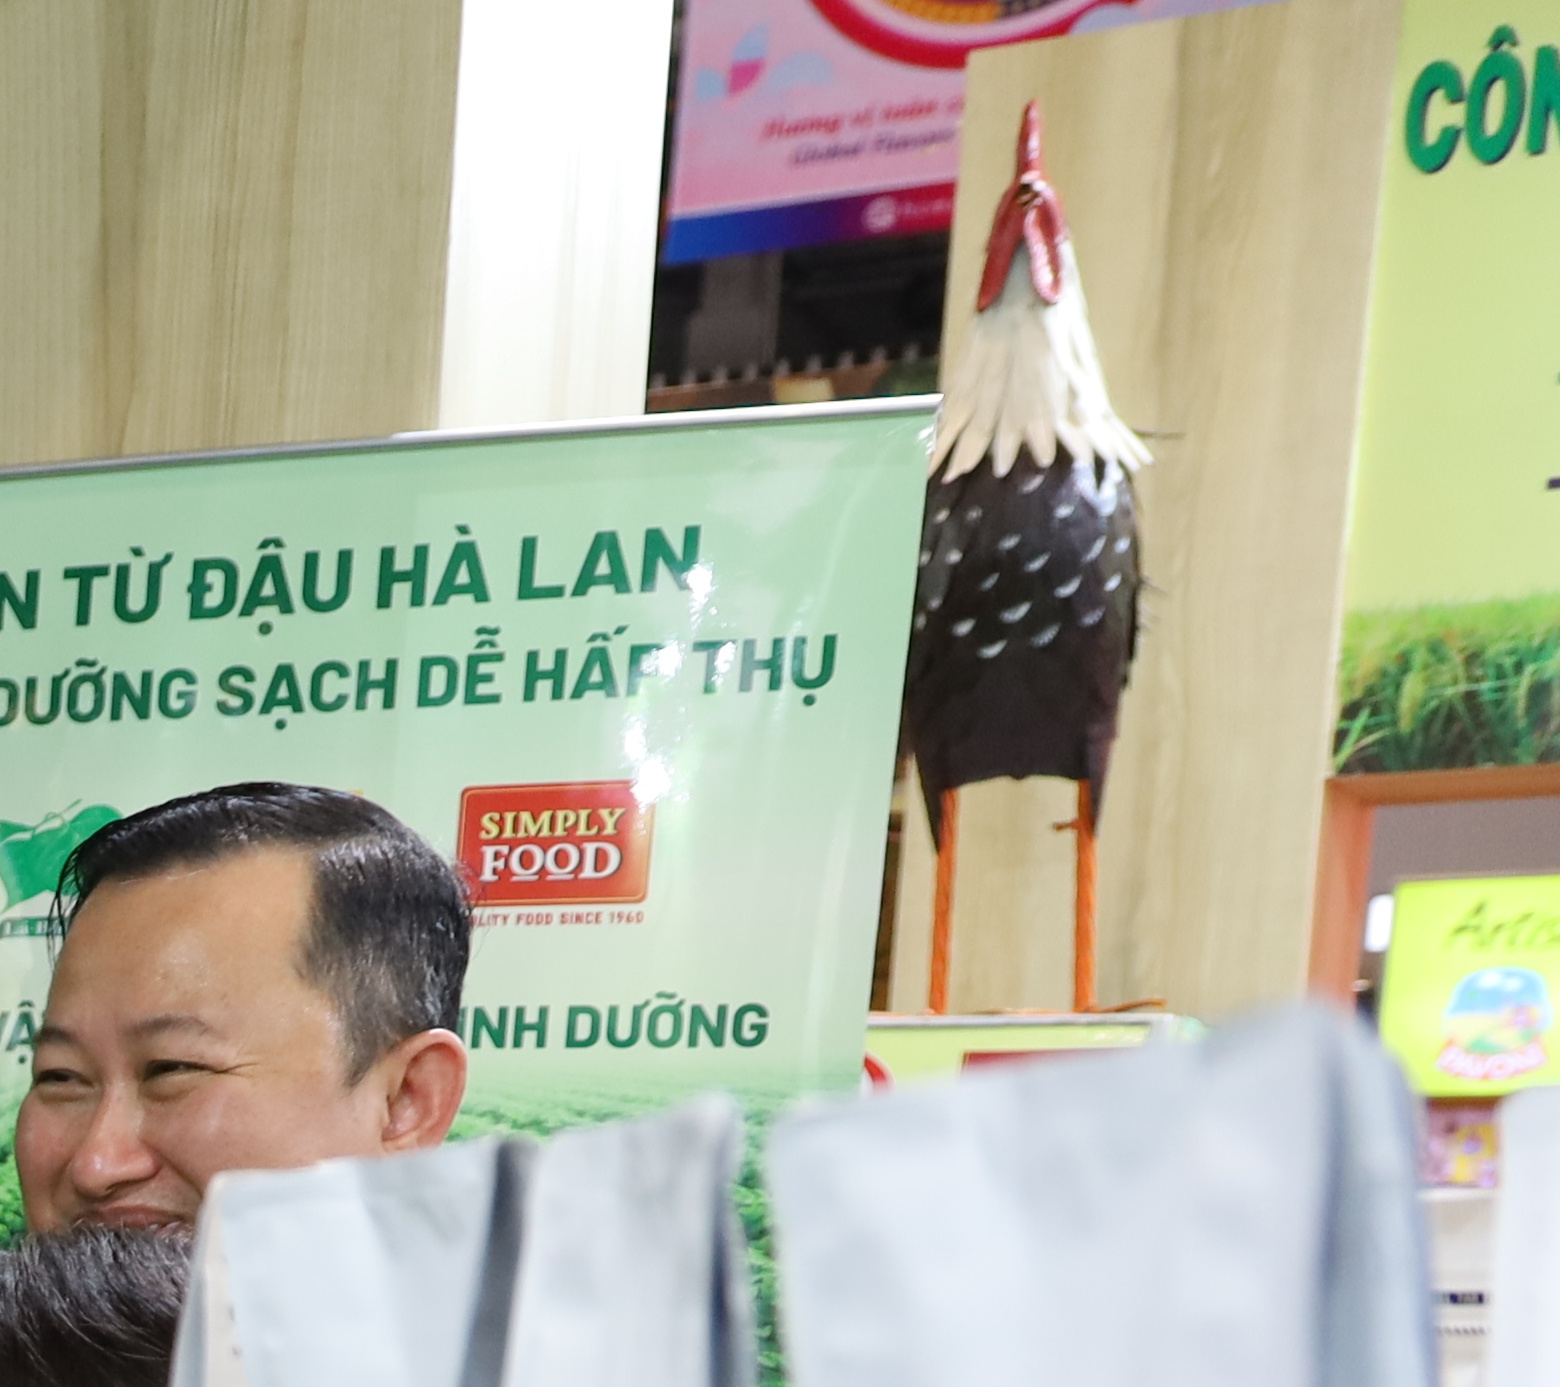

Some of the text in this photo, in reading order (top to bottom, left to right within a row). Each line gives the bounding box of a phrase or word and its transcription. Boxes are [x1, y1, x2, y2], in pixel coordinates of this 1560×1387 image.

[62, 545, 174, 628] TỪ
[186, 535, 355, 638] ĐẬU
[375, 522, 493, 609] HÀ
[515, 523, 704, 602] LAN
[214, 656, 400, 731] SẠCH
[415, 626, 506, 710] DỄ
[520, 625, 678, 703] HẤP
[691, 632, 839, 708] THỤ
[479, 807, 627, 840] SIMPLY
[479, 841, 623, 883] FOOD
[515, 912, 554, 926] FOOD
[560, 911, 603, 925] SINCE
[609, 910, 645, 924] 1960
[458, 989, 771, 1050] INH DƯỠNG
